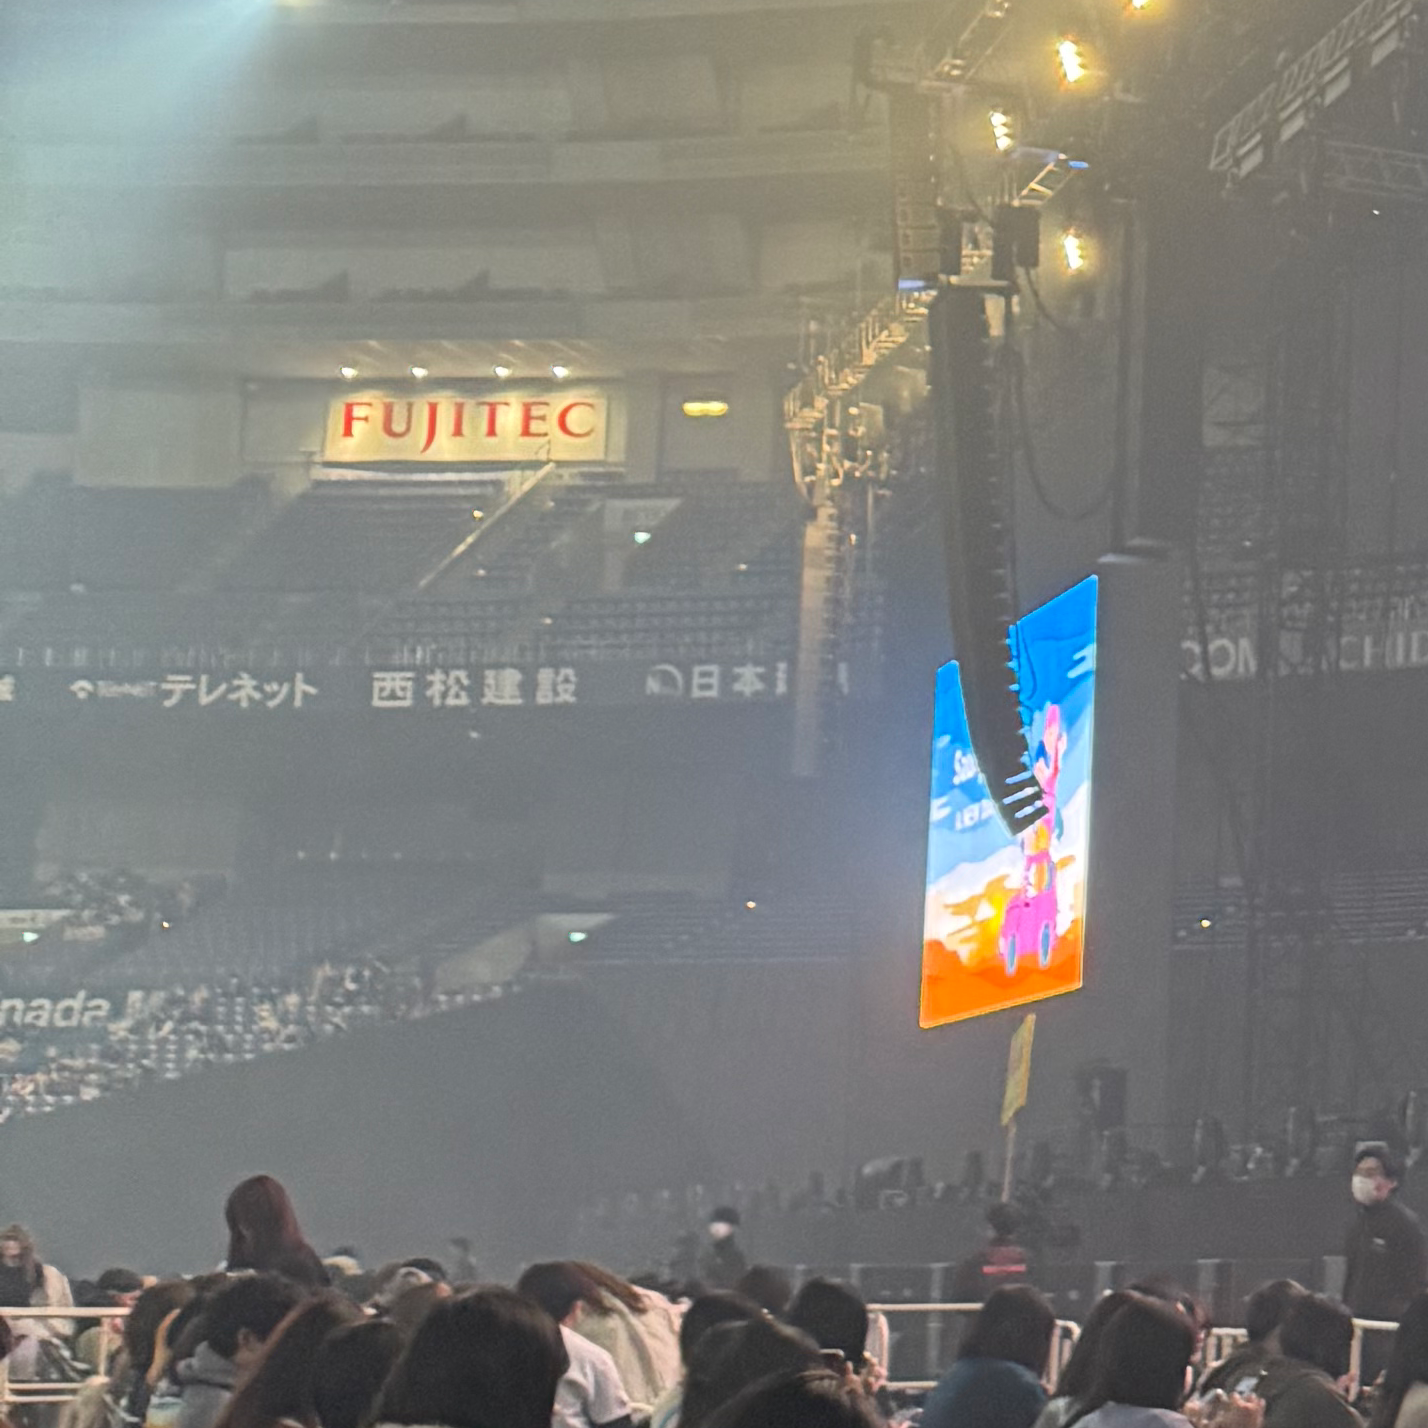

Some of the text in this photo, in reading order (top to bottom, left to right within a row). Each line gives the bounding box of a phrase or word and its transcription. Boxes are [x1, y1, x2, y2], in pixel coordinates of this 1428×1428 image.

[341, 401, 596, 454] FUJITEC
[160, 673, 319, 708] テレネット
[371, 668, 578, 708] 西松建設
